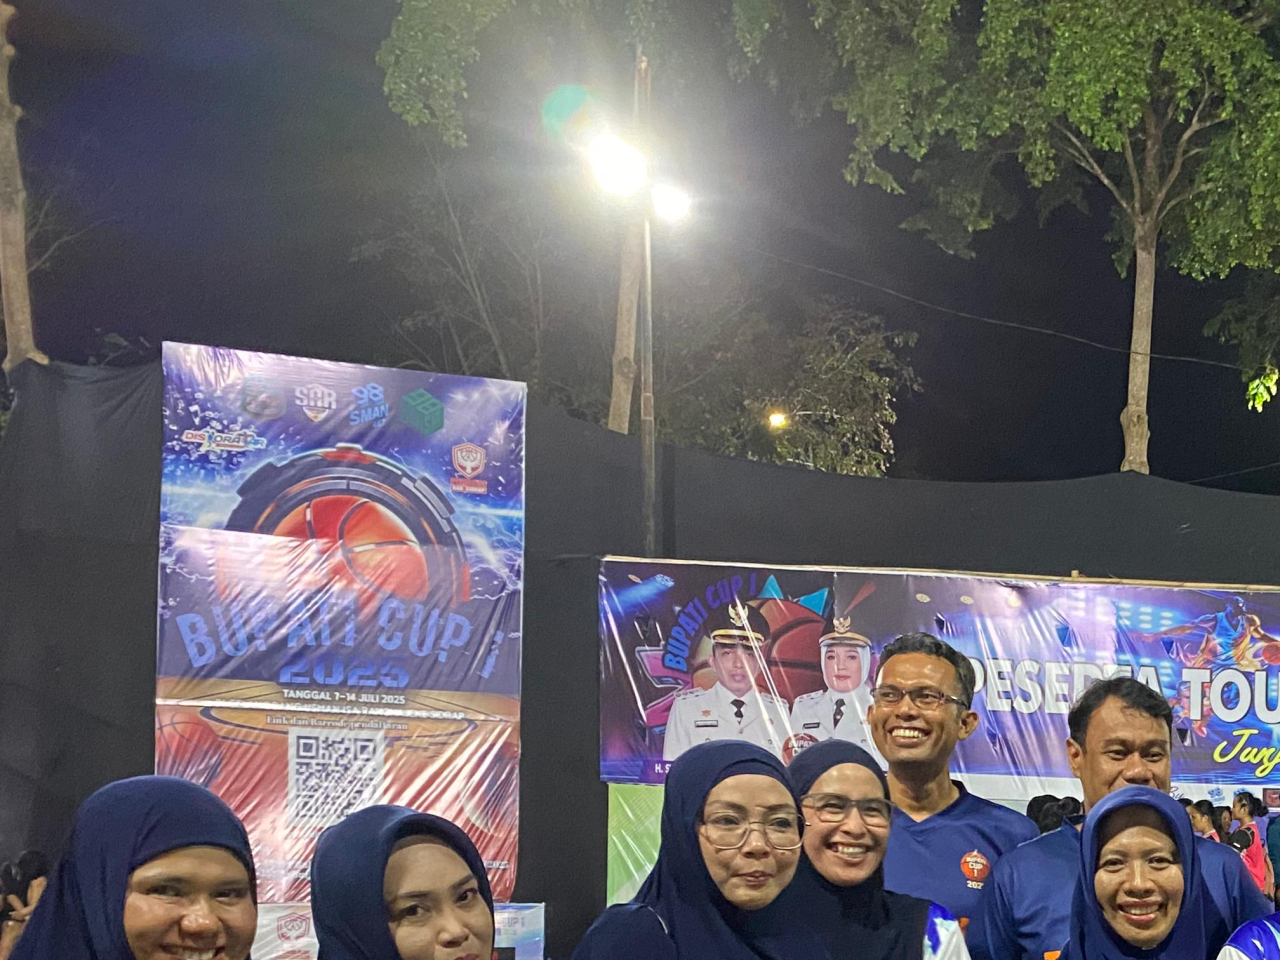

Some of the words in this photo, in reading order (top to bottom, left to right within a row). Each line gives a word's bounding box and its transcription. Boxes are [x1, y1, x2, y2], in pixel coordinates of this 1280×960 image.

[294, 385, 337, 410] SAR
[349, 403, 389, 426] SMAN
[376, 597, 474, 662] CUP
[662, 597, 709, 673] BUPATI
[704, 574, 744, 610] CUP
[278, 655, 410, 688] 2025
[282, 688, 332, 700] TANGGAL
[358, 693, 379, 703] JULI
[381, 694, 406, 705] 2025
[266, 715, 288, 725] Link
[290, 717, 308, 725] dan
